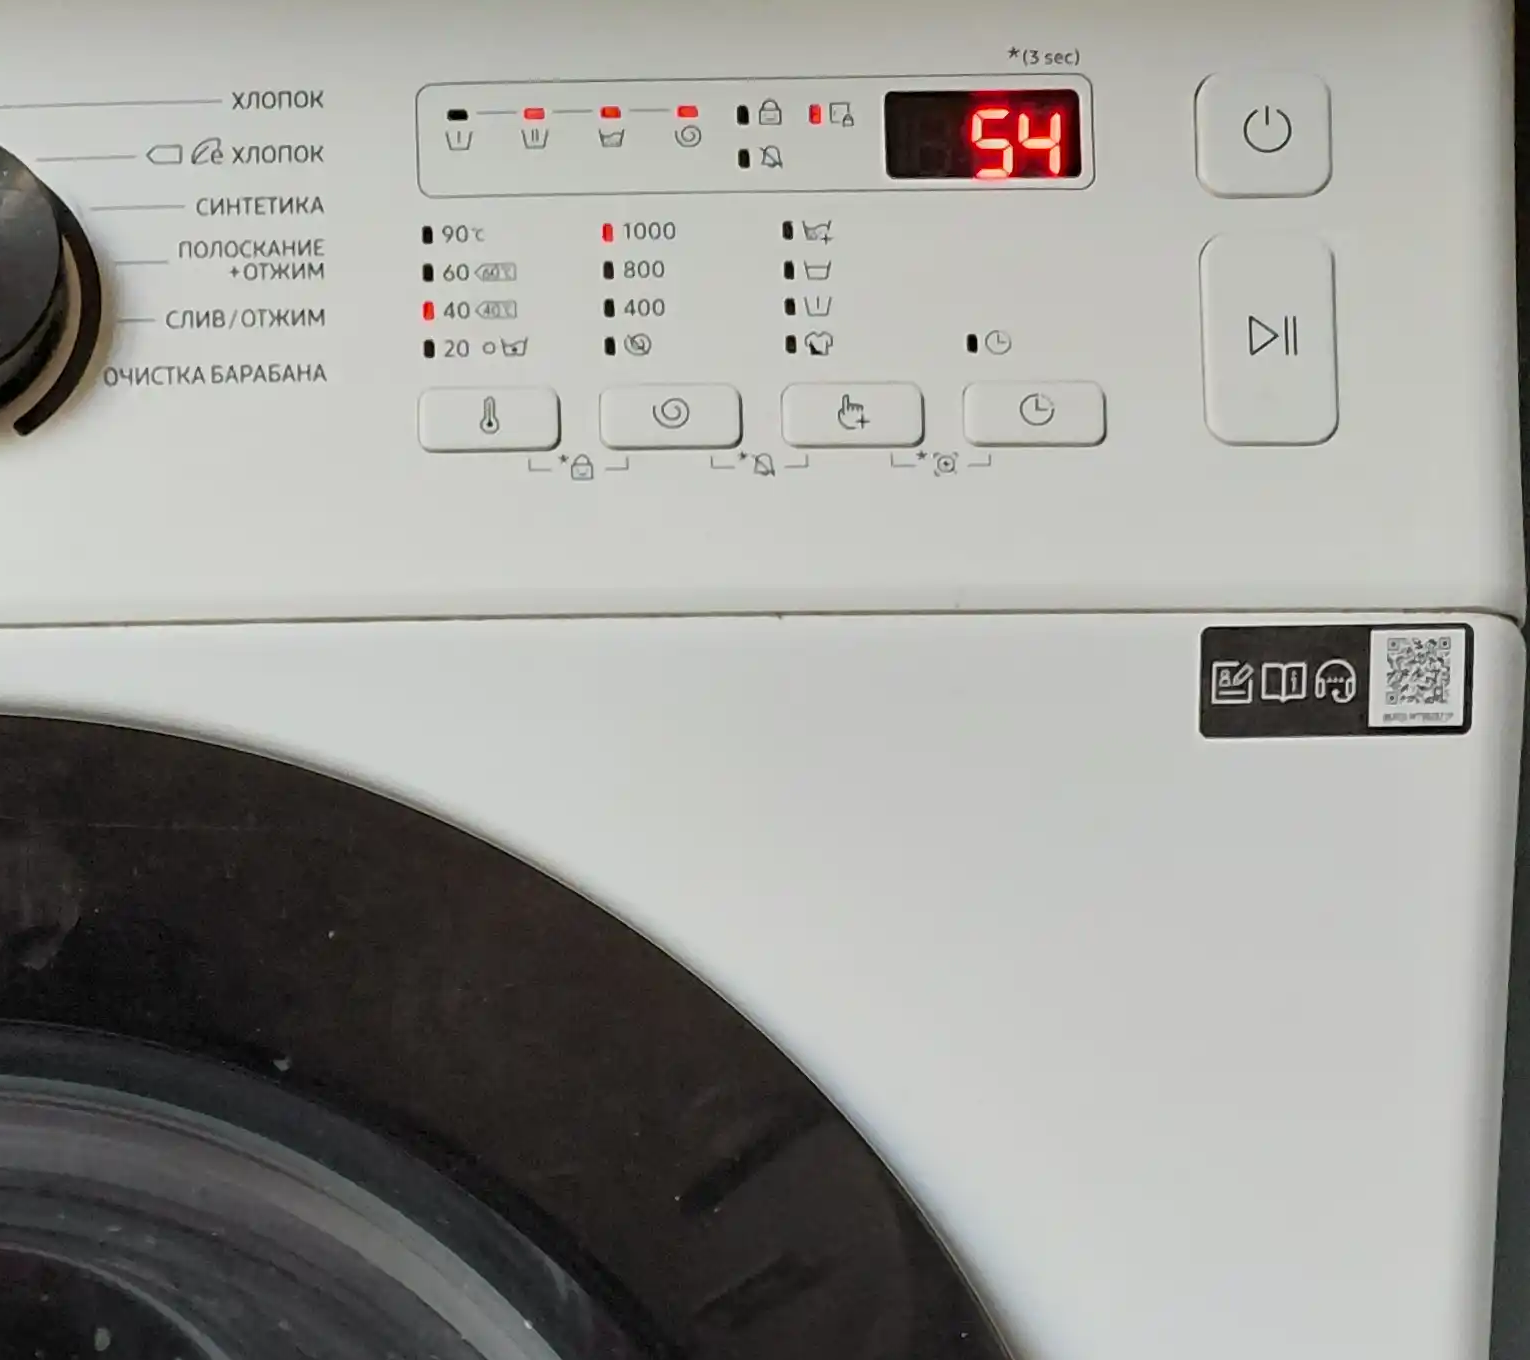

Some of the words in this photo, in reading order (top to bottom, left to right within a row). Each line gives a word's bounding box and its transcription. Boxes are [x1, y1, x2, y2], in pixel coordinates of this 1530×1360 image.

[1043, 48, 1081, 67] sec)
[231, 89, 324, 110] ХЛОПОК
[971, 107, 1062, 179] 54
[231, 144, 324, 165] ХЛОПОК
[195, 195, 325, 217] СИНТЕТИКА
[622, 221, 676, 241] 1000
[178, 238, 325, 259] ПОЛОСКАНИЕ
[229, 261, 325, 282] +ОТЖИМ
[443, 263, 470, 282] 60
[623, 259, 665, 279] 800
[443, 301, 471, 320] 40
[623, 298, 666, 317] 400
[443, 338, 470, 358] 20
[103, 366, 206, 387] ОЧИСТКА
[210, 364, 328, 383] БАРАБАНА
